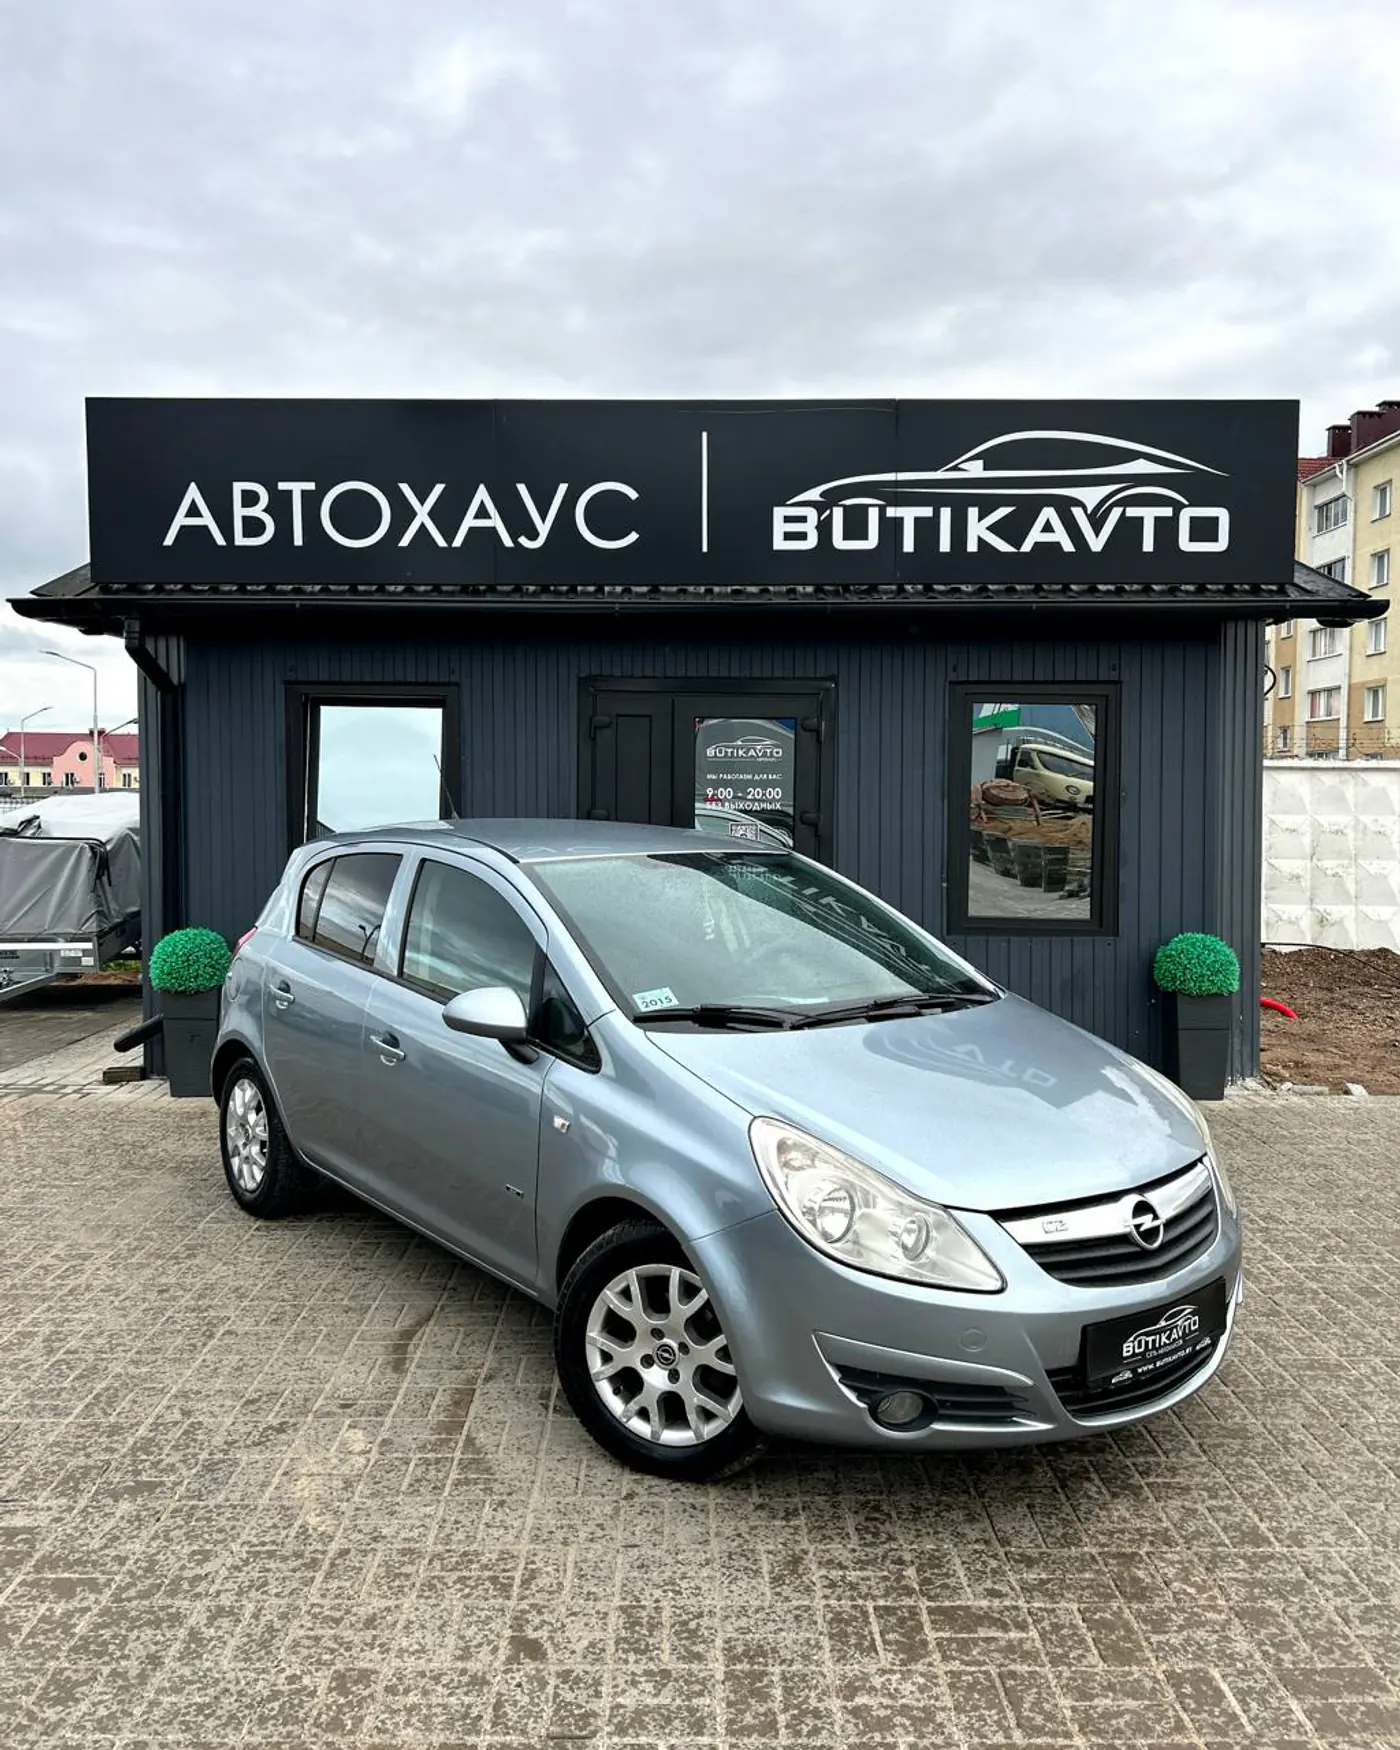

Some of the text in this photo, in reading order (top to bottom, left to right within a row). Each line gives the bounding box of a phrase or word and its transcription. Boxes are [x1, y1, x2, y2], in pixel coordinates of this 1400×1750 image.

[163, 481, 640, 549] АВТОХАУС
[772, 506, 1230, 553] BUTIKAVTO
[706, 748, 783, 757] BUTIKAVTO
[706, 787, 733, 799] 9:00
[746, 787, 782, 799] 20:00
[724, 801, 782, 811] ВЫХОДНЫХ
[641, 995, 673, 1009] 2015
[1122, 1315, 1199, 1358] BUTIKAVTO
